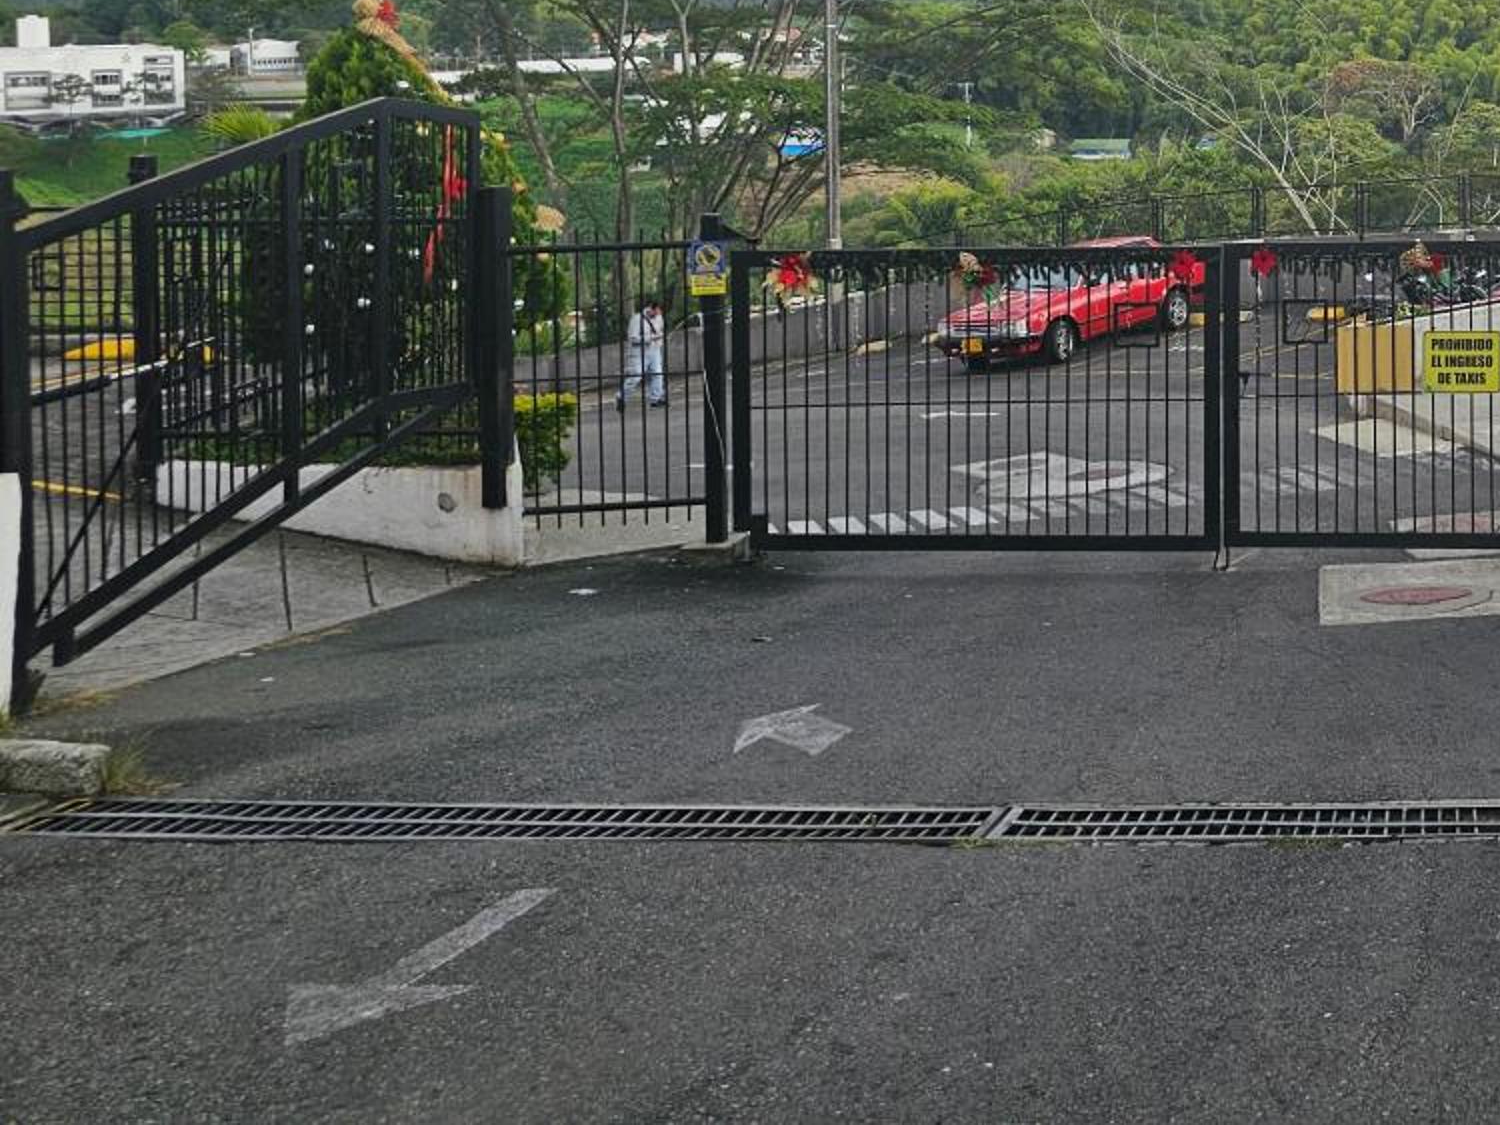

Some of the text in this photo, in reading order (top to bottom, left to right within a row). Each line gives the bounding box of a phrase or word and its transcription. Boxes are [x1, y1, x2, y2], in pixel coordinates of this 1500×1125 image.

[1431, 338, 1493, 351] PROHIBIDO
[1431, 355, 1493, 368] EL INGRESO
[1437, 372, 1487, 384] DE TAXIS
